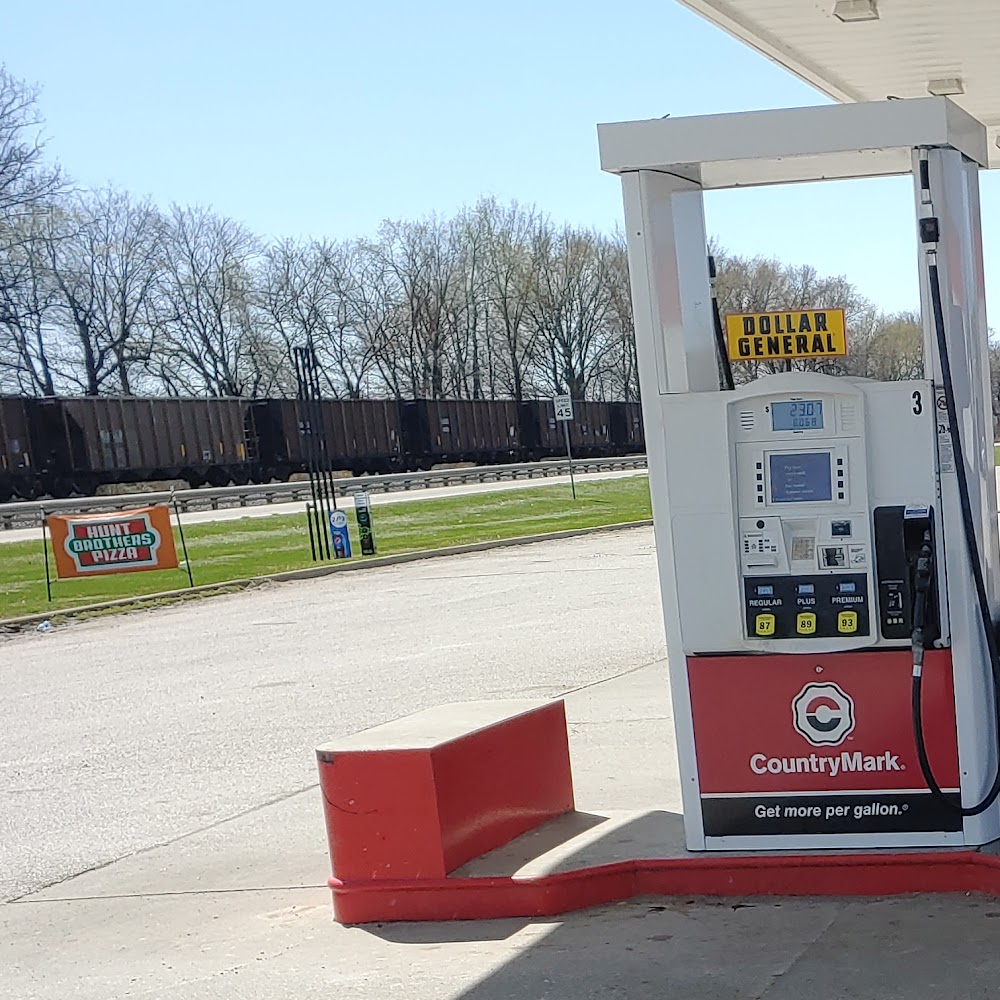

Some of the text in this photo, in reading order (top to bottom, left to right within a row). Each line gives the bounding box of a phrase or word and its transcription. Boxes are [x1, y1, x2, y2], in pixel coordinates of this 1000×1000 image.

[743, 313, 828, 336] DOLLAR
[738, 333, 836, 357] GENERAL
[912, 391, 923, 416] 3
[557, 407, 571, 417] 45
[86, 523, 131, 539] HUNT
[73, 533, 152, 552] BROTHERS
[91, 547, 139, 563] PIZZA
[749, 599, 782, 607] REGULAR
[831, 596, 864, 604] PREMIUM
[759, 621, 771, 630] 87
[800, 620, 812, 628] 89
[841, 618, 853, 627] 93
[755, 805, 781, 818] Get
[784, 805, 822, 818] more
[826, 805, 850, 819] per
